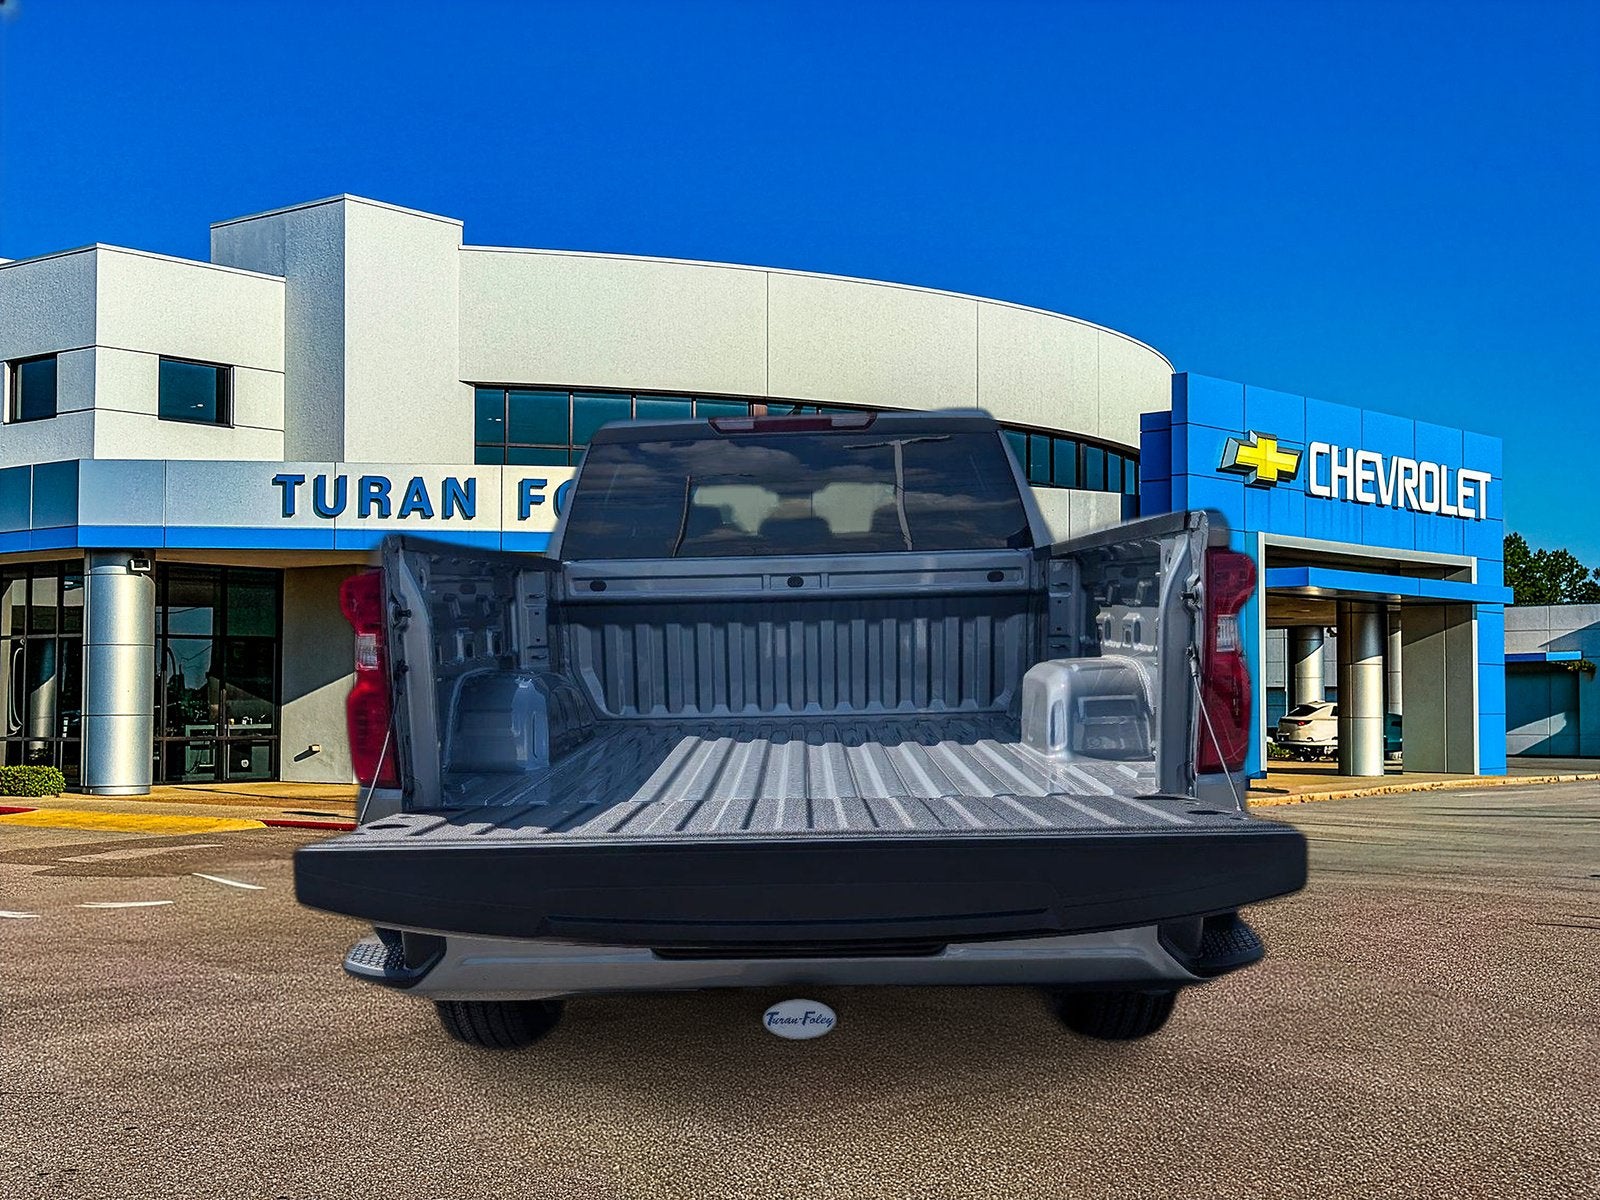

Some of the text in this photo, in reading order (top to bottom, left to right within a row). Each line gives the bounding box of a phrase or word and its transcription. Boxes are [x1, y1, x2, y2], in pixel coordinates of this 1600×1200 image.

[271, 473, 477, 521] TURAN
[1308, 441, 1492, 520] CHEVROLET
[766, 1010, 834, 1028] Turan-Foley
